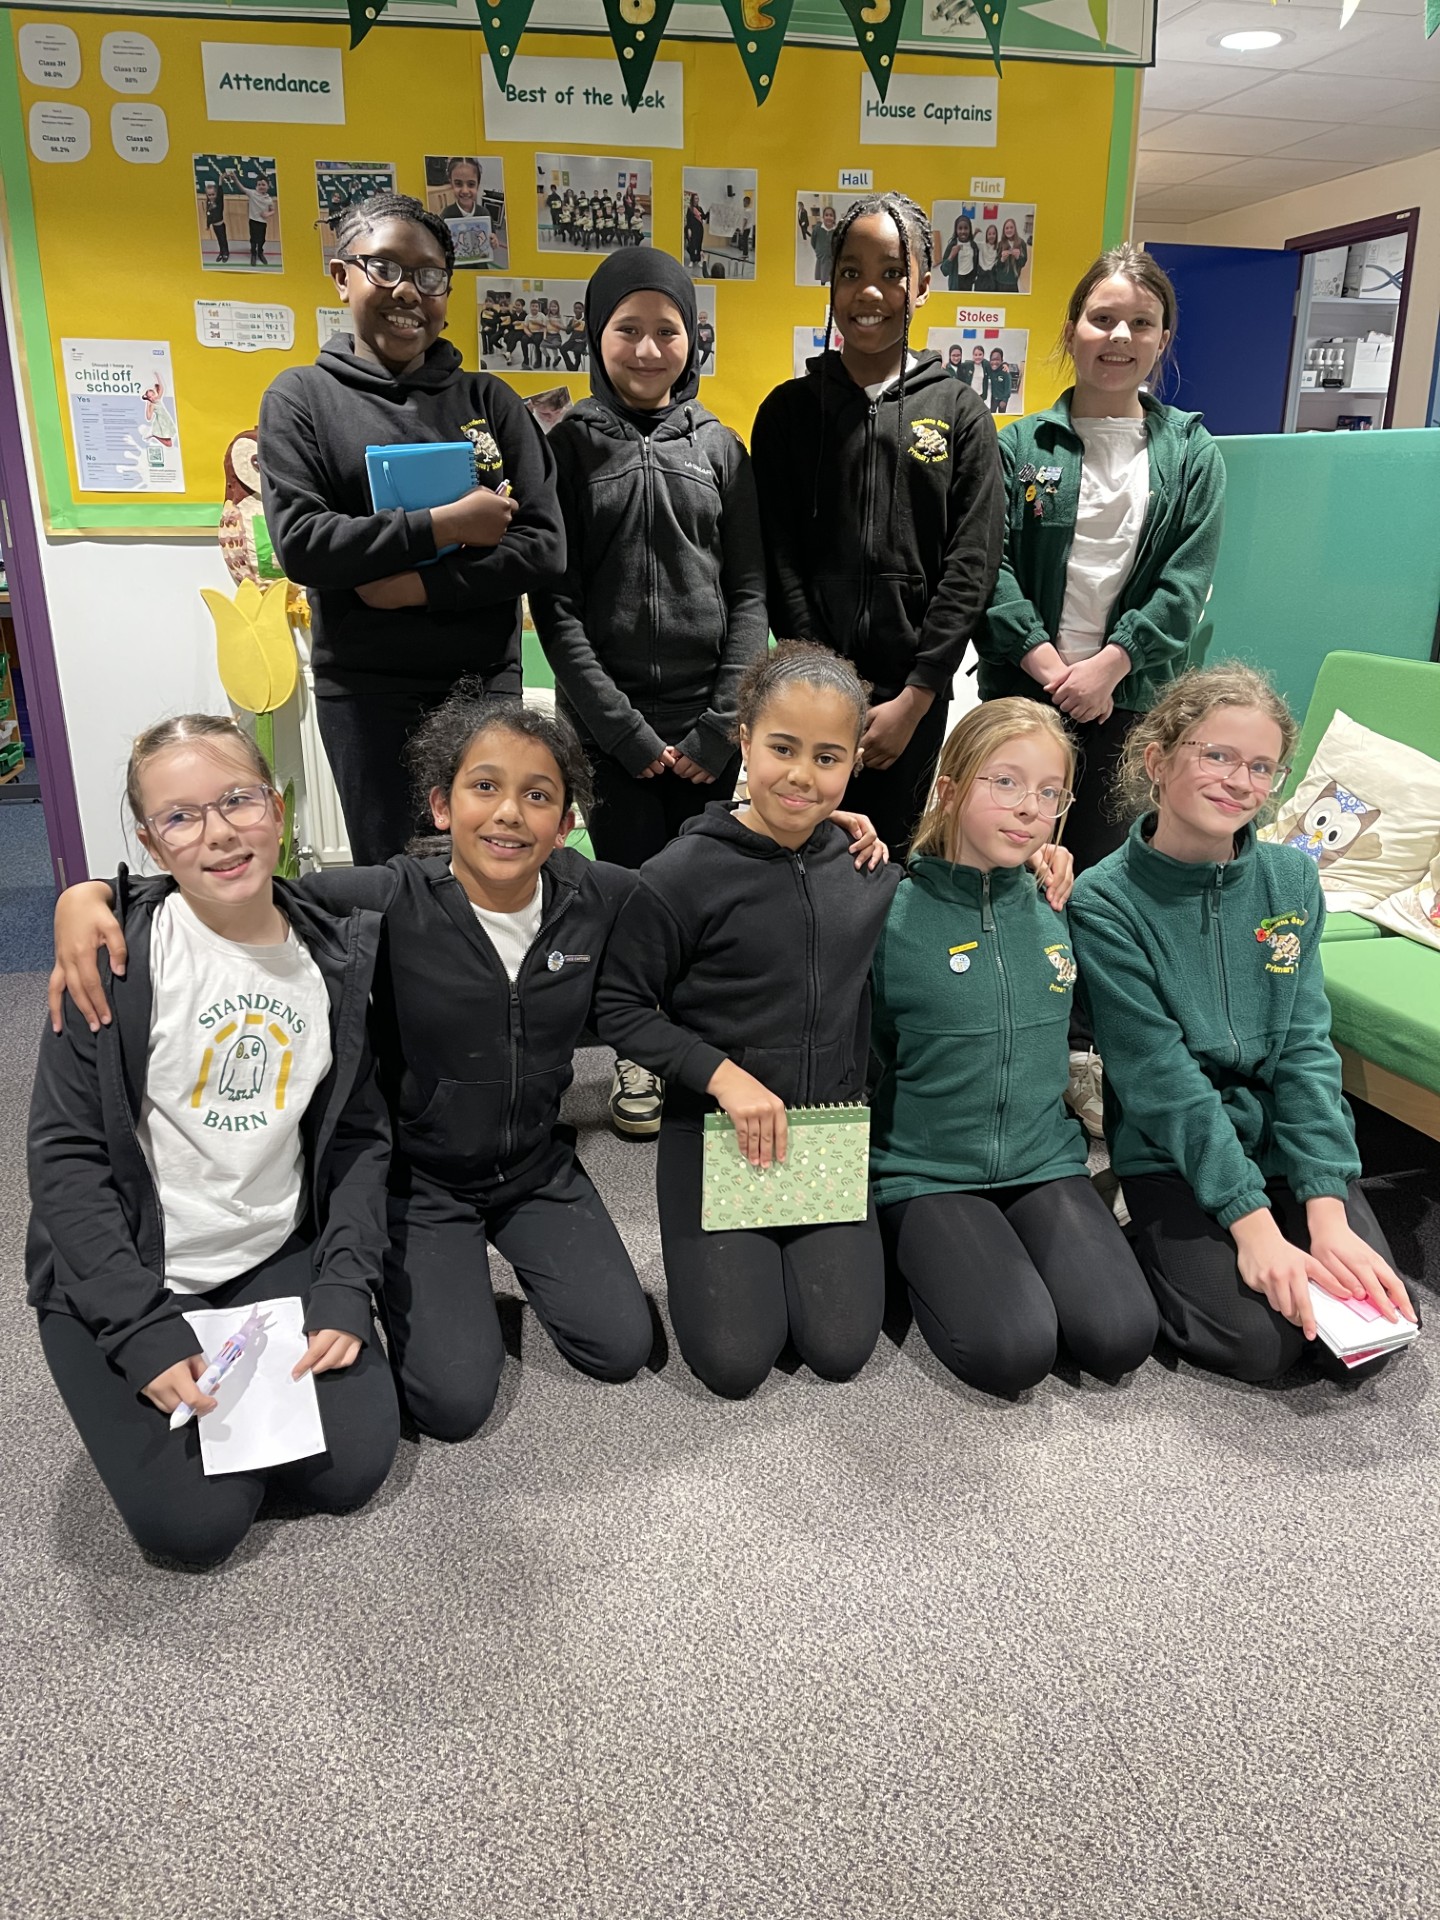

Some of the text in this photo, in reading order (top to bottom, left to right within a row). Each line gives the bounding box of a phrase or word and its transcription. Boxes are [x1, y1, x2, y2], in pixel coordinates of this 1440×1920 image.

[38, 59, 56, 67] Class
[113, 65, 132, 73] Class
[219, 72, 331, 94] Attendance
[506, 84, 547, 103] Best
[555, 86, 574, 105] of
[583, 87, 613, 105] the
[866, 99, 993, 125] House Captains
[42, 134, 60, 142] Class
[842, 173, 868, 185] Hall
[973, 181, 1000, 193] Flint
[959, 310, 999, 323] Stokes
[75, 369, 131, 381] child off
[86, 382, 141, 394] school?
[1265, 963, 1295, 975] Primary
[199, 993, 306, 1034] STANDENS
[203, 1110, 268, 1132] BARN
